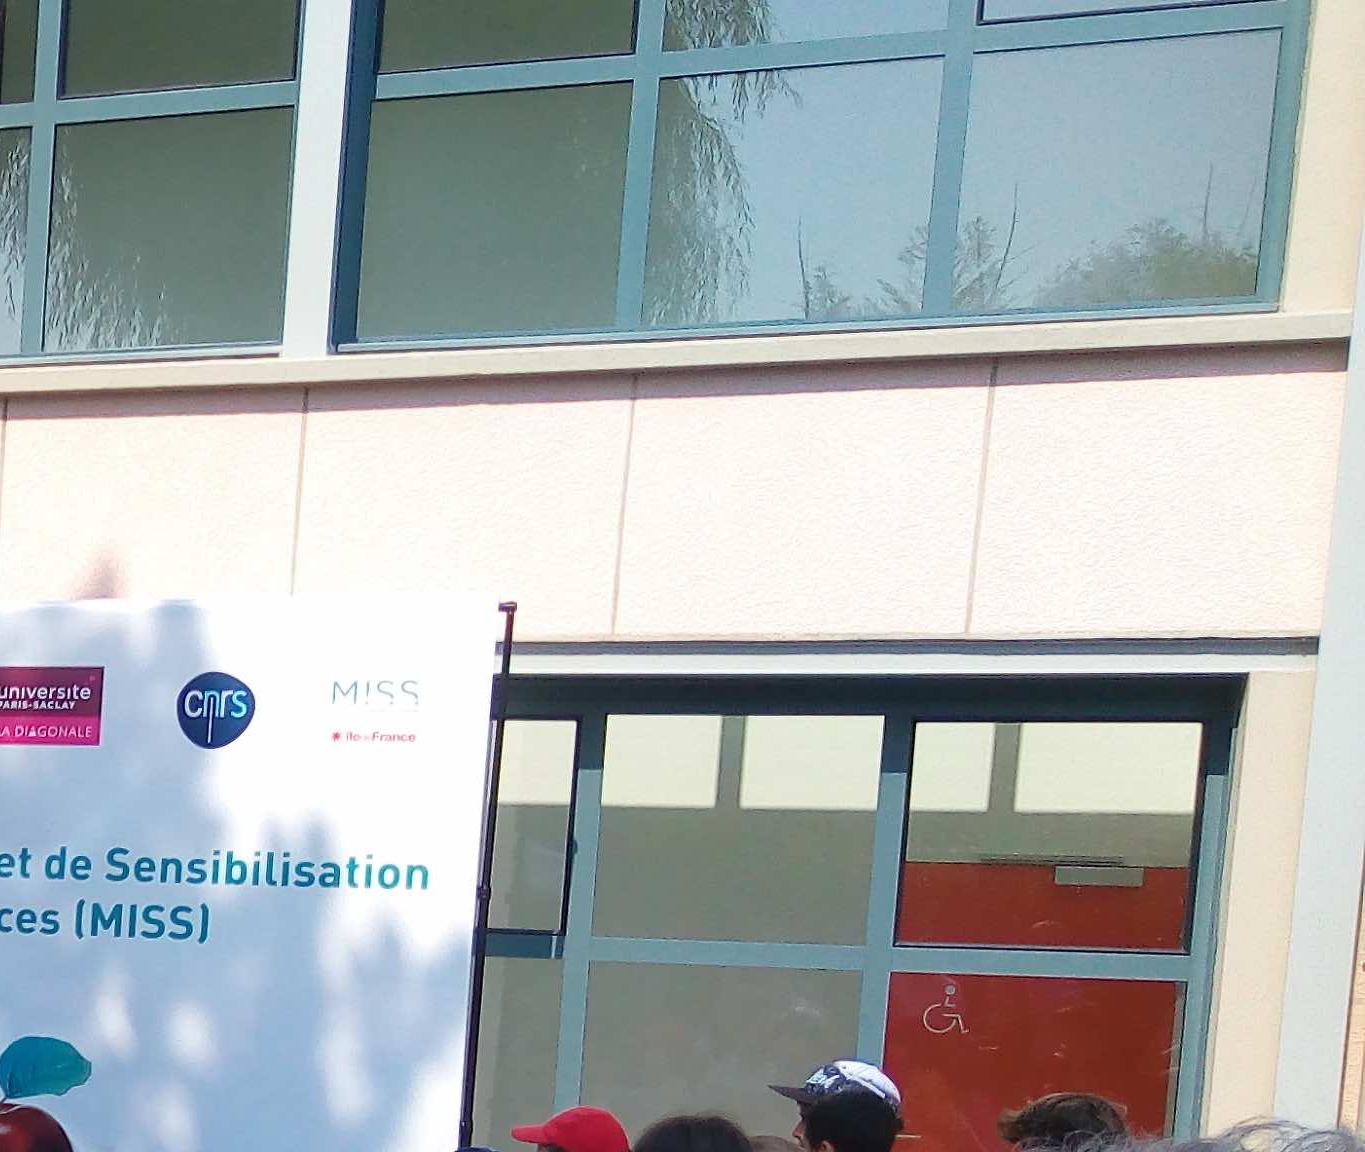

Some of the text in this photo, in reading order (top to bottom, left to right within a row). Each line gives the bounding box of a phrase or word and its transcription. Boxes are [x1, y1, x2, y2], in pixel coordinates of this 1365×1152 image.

[14, 725, 93, 738] DIAGONALE
[44, 846, 93, 880] de
[105, 847, 430, 891] Sensibilisation
[74, 899, 210, 944] (MISS)
